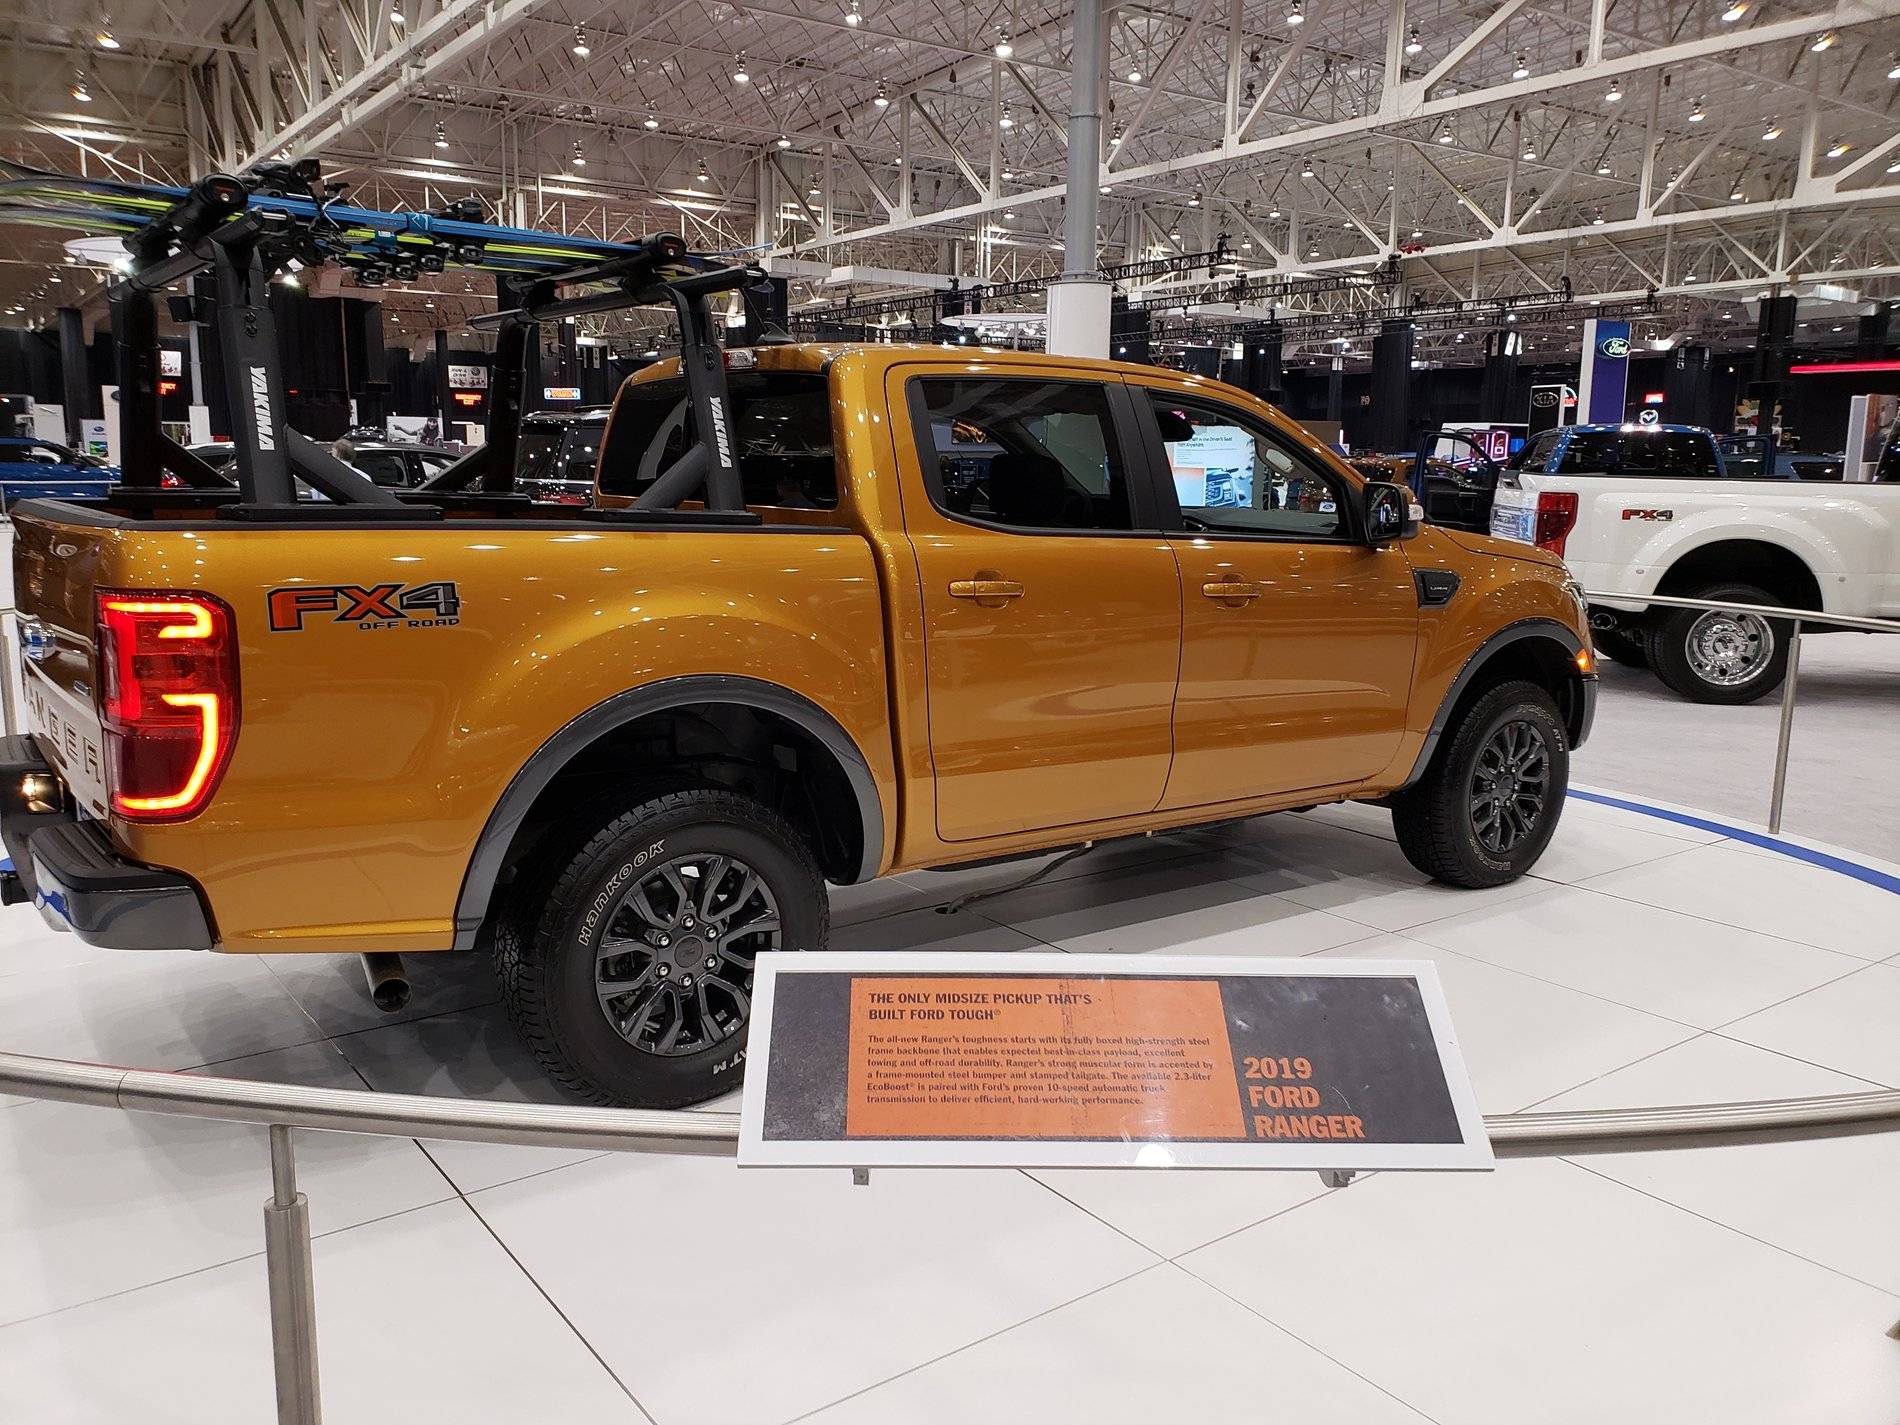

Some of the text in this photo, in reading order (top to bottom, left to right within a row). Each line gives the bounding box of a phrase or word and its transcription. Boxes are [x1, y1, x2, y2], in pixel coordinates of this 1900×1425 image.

[1608, 340, 1628, 355] Ford
[250, 366, 275, 450] YAKIMA
[709, 396, 732, 468] YAKIMA
[1622, 508, 1673, 521] FX4
[267, 581, 460, 632] FX4
[359, 618, 460, 631] OFF ROAD
[868, 993, 1092, 1004] THE ONLY MIDSIZE PICKUP THAT'S
[868, 1009, 906, 1020] BUILT
[910, 1009, 944, 1020] FORD
[868, 1035, 1210, 1047] The all-new Ranger's toughness starts with its fully boxed high-strength steel
[868, 1047, 894, 1055] frame
[896, 1047, 940, 1055] backbone
[943, 1048, 962, 1056] that
[964, 1048, 998, 1056] enables
[1000, 1048, 1041, 1058] expected
[1044, 1049, 1100, 1057] best-in-class
[1144, 1050, 1185, 1058] excellent
[867, 1059, 897, 1068] towing
[900, 1059, 917, 1067] and
[919, 1060, 956, 1068] off-road
[1006, 1060, 1044, 1070] Ranger's
[1048, 1061, 1076, 1070] strong
[1079, 1061, 1121, 1069] muscular
[1124, 1061, 1146, 1069] form
[1148, 1062, 1156, 1070] is
[1159, 1062, 1200, 1070] accented
[1203, 1062, 1213, 1071] by
[1243, 1057, 1312, 1080] 2019
[972, 1072, 1007, 1081] bumper
[1030, 1072, 1068, 1081] stamped
[918, 1083, 925, 1091] is
[928, 1083, 957, 1093] paired
[960, 1084, 979, 1092] with
[982, 1084, 1010, 1092] Ford's
[1048, 1084, 1090, 1094] 10-speed
[1092, 1084, 1138, 1092] automatic
[1141, 1085, 1165, 1093] truck
[1018, 1096, 1079, 1106] hard-working
[1247, 1086, 1321, 1109] FORD
[1253, 1115, 1366, 1139] RANGER
